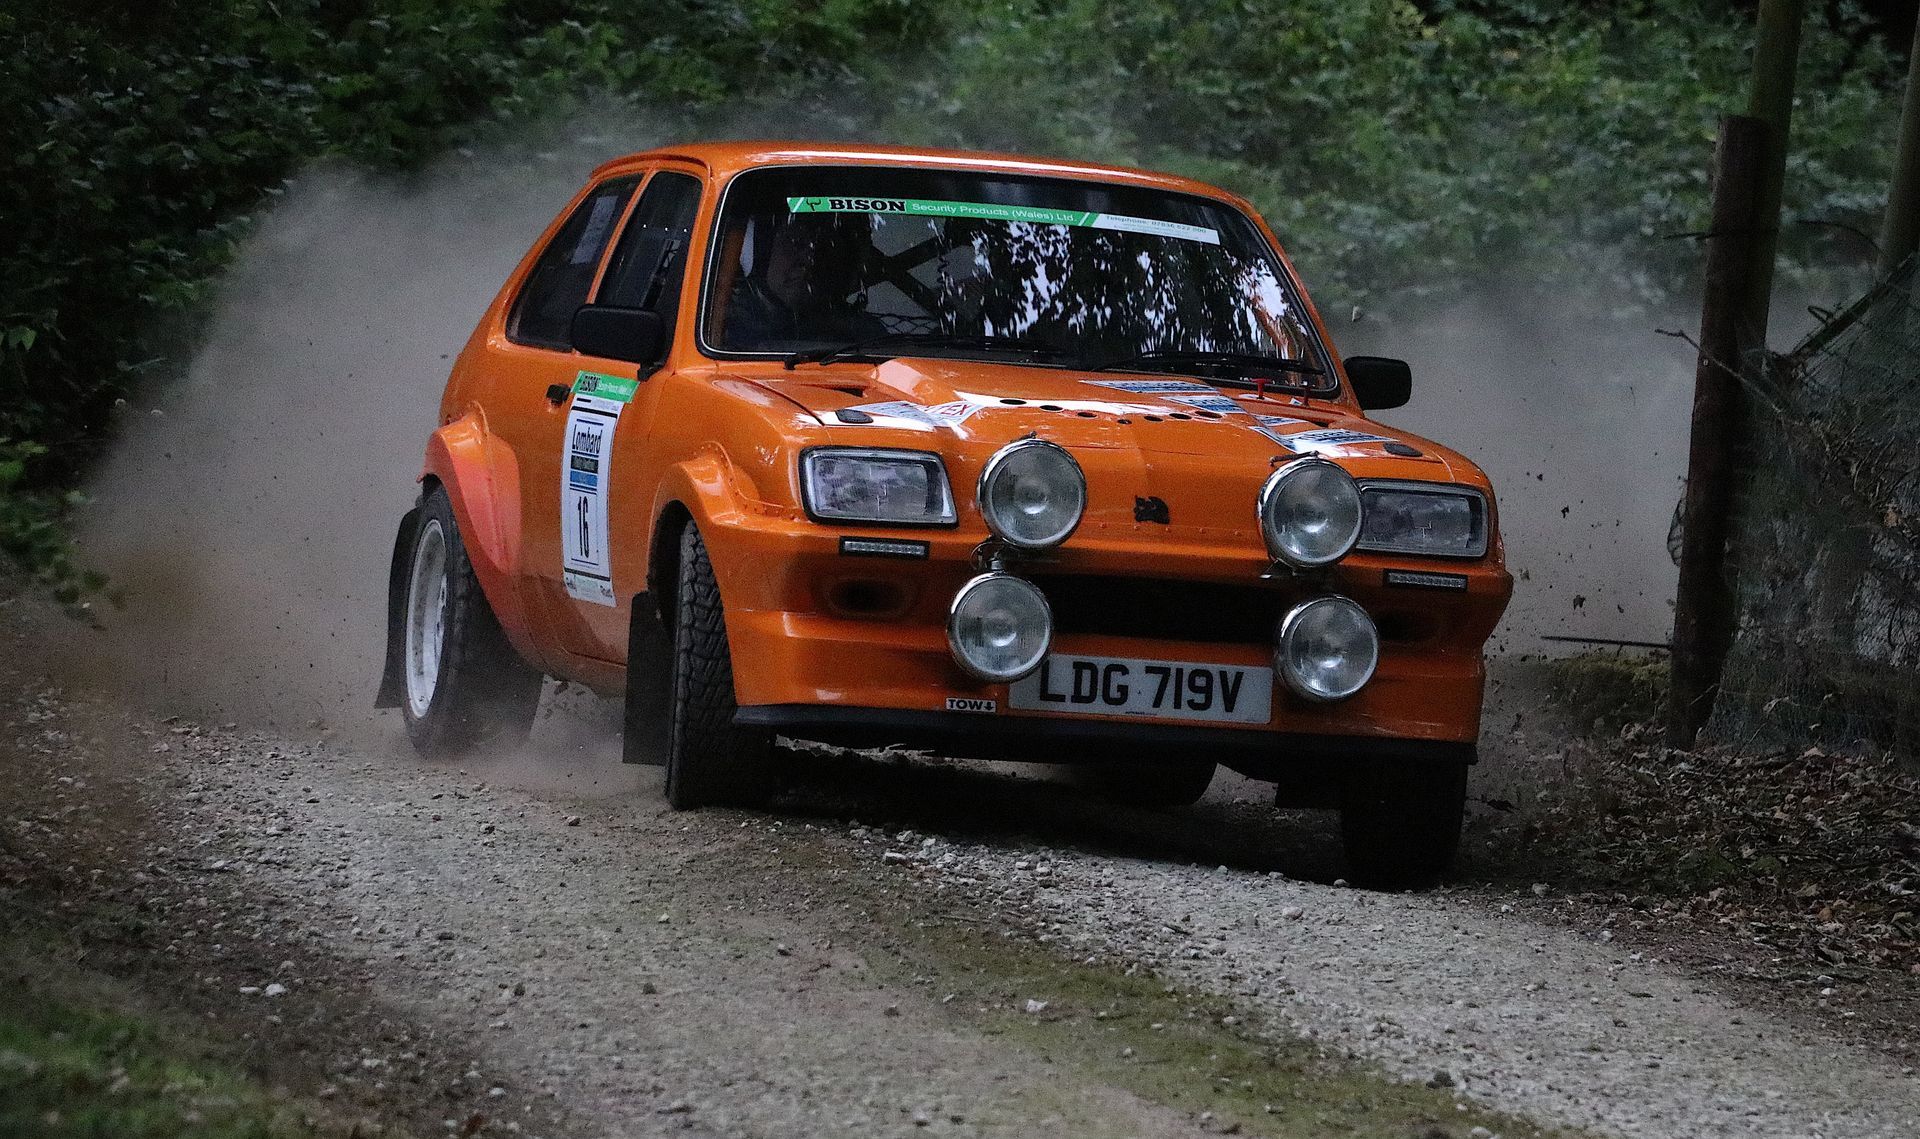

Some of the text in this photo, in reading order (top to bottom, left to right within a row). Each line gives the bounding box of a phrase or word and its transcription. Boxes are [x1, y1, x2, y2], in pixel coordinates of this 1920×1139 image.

[829, 199, 1078, 222] BISON Security Products (Wales) Ltd.
[572, 424, 603, 454] Lombard
[577, 496, 590, 559] 16
[1039, 660, 1245, 713] LDG 719V
[948, 698, 984, 711] TOW
